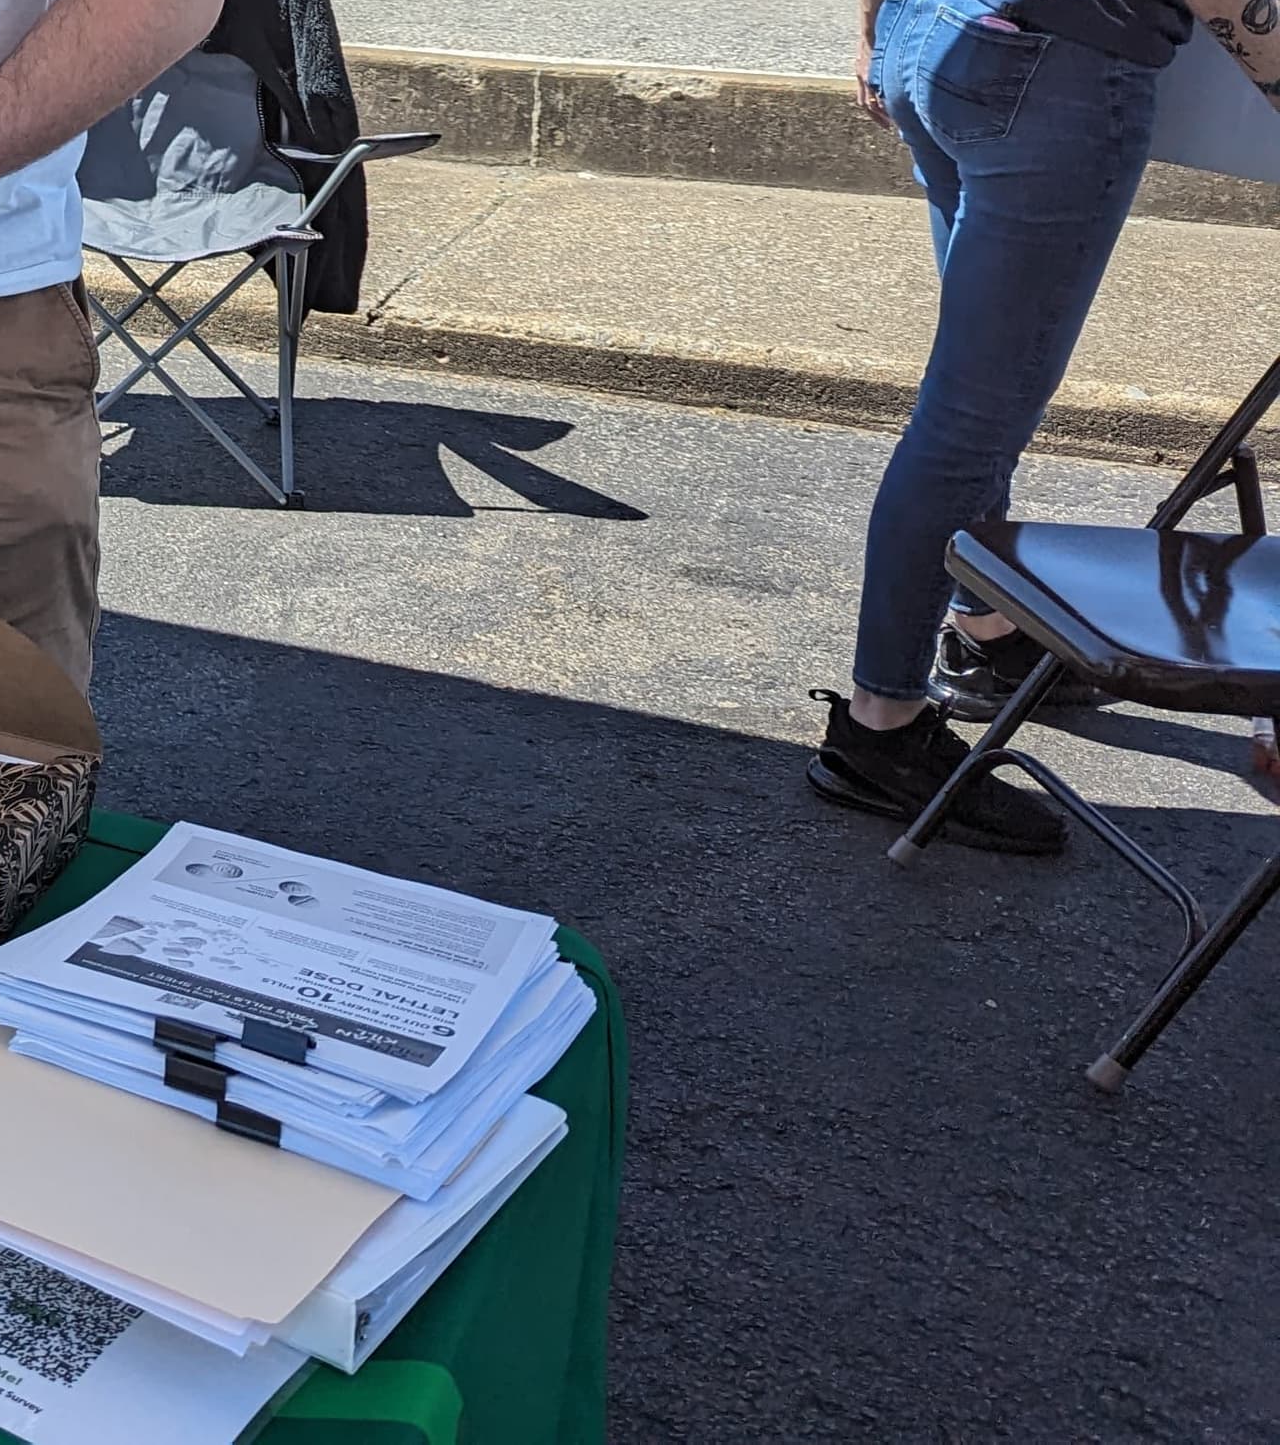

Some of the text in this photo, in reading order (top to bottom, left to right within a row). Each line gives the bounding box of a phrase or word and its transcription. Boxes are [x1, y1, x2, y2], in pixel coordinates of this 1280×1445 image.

[146, 971, 192, 988] SHEET
[195, 985, 231, 999] FACT
[297, 967, 364, 992] DOSE
[234, 995, 273, 1011] PILLS
[261, 977, 456, 1038] 6 OUT OF EVERY 10 PILLS
[371, 988, 460, 1020] LETHAL
[5, 1389, 44, 1415] Survey
